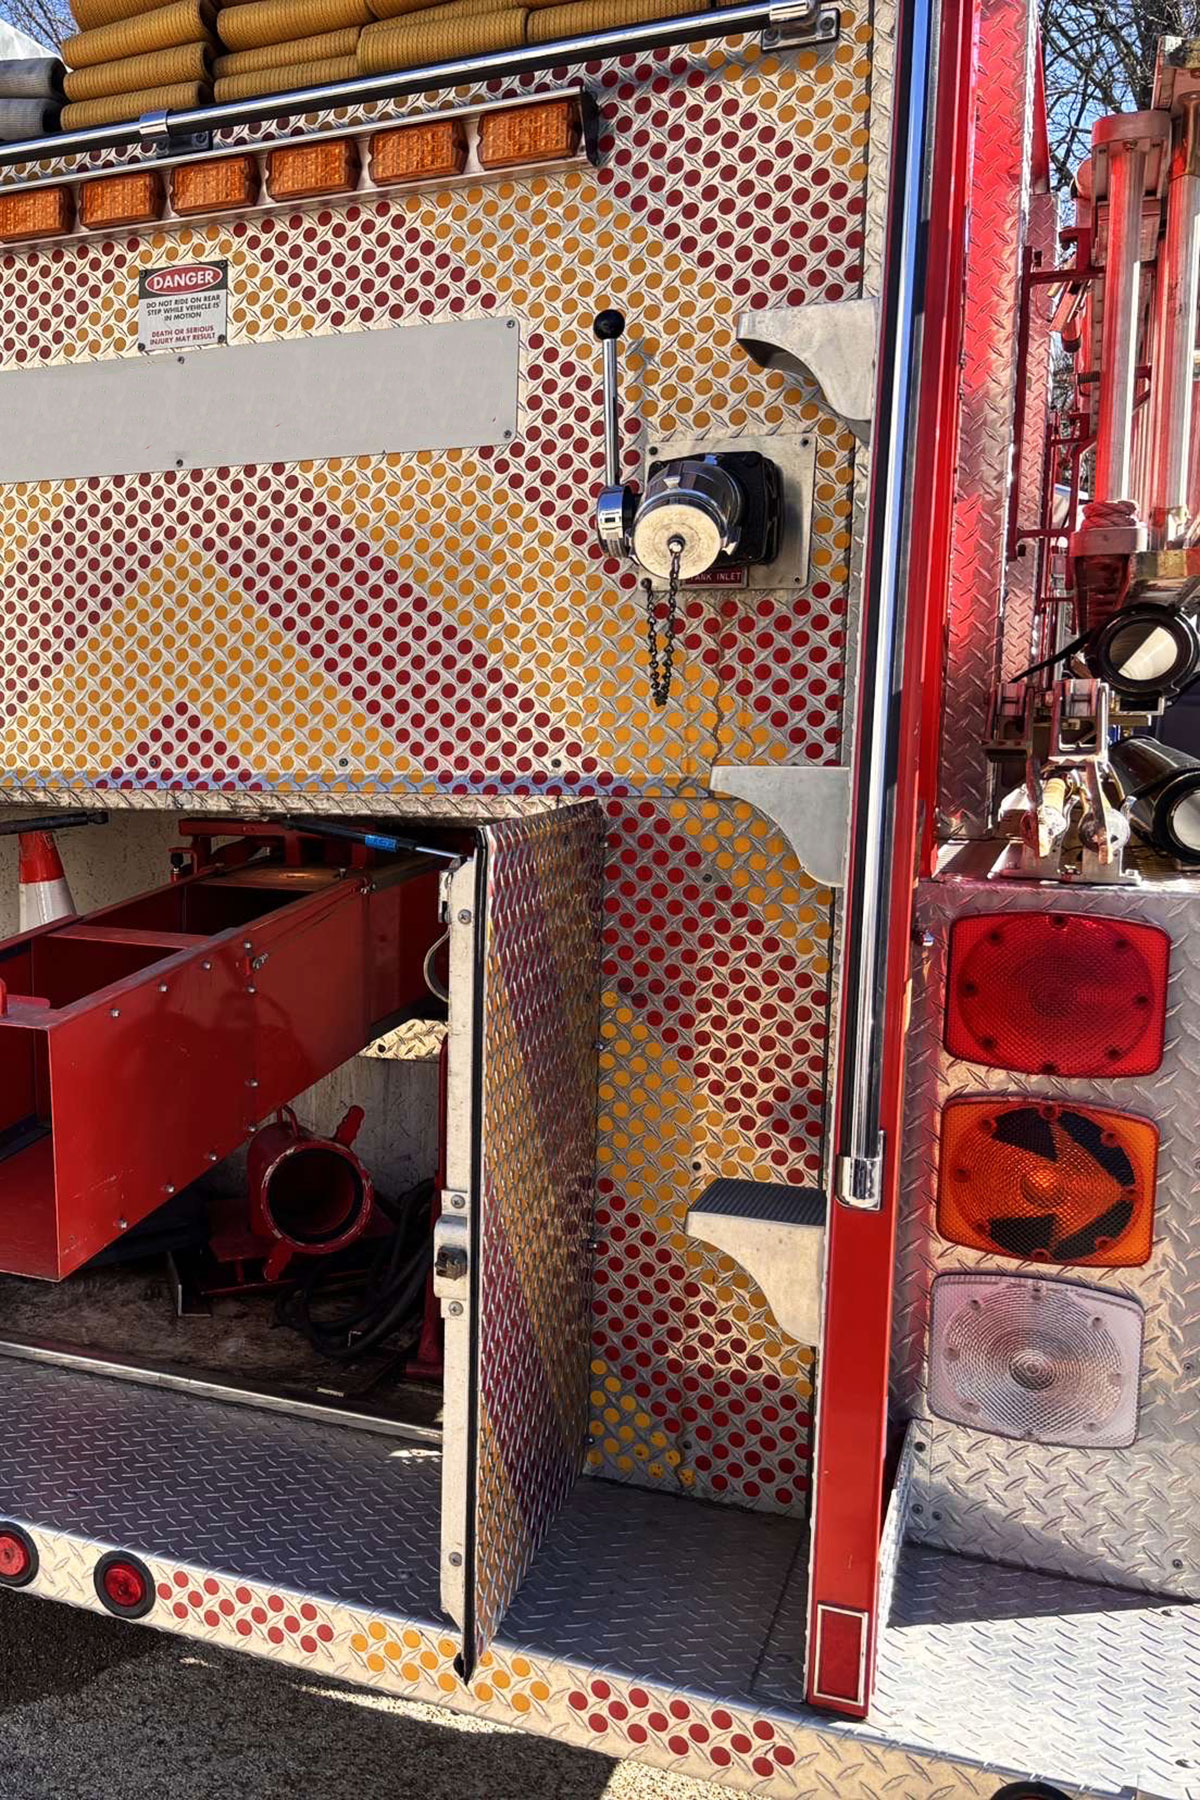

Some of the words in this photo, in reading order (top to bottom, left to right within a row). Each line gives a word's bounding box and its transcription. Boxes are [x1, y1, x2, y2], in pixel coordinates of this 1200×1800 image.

[153, 270, 214, 290] DANGER
[158, 299, 172, 307] NOT
[203, 294, 220, 302] REAR
[163, 306, 184, 314] WHILE
[185, 303, 211, 311] VEHICLE
[173, 312, 202, 320] MOTION
[151, 329, 173, 338] DEATH
[186, 325, 214, 334] SERIOUS
[150, 337, 173, 345] INJURY
[176, 335, 191, 343] MAY
[192, 332, 216, 341] RESULT
[716, 572, 742, 581] INLET
